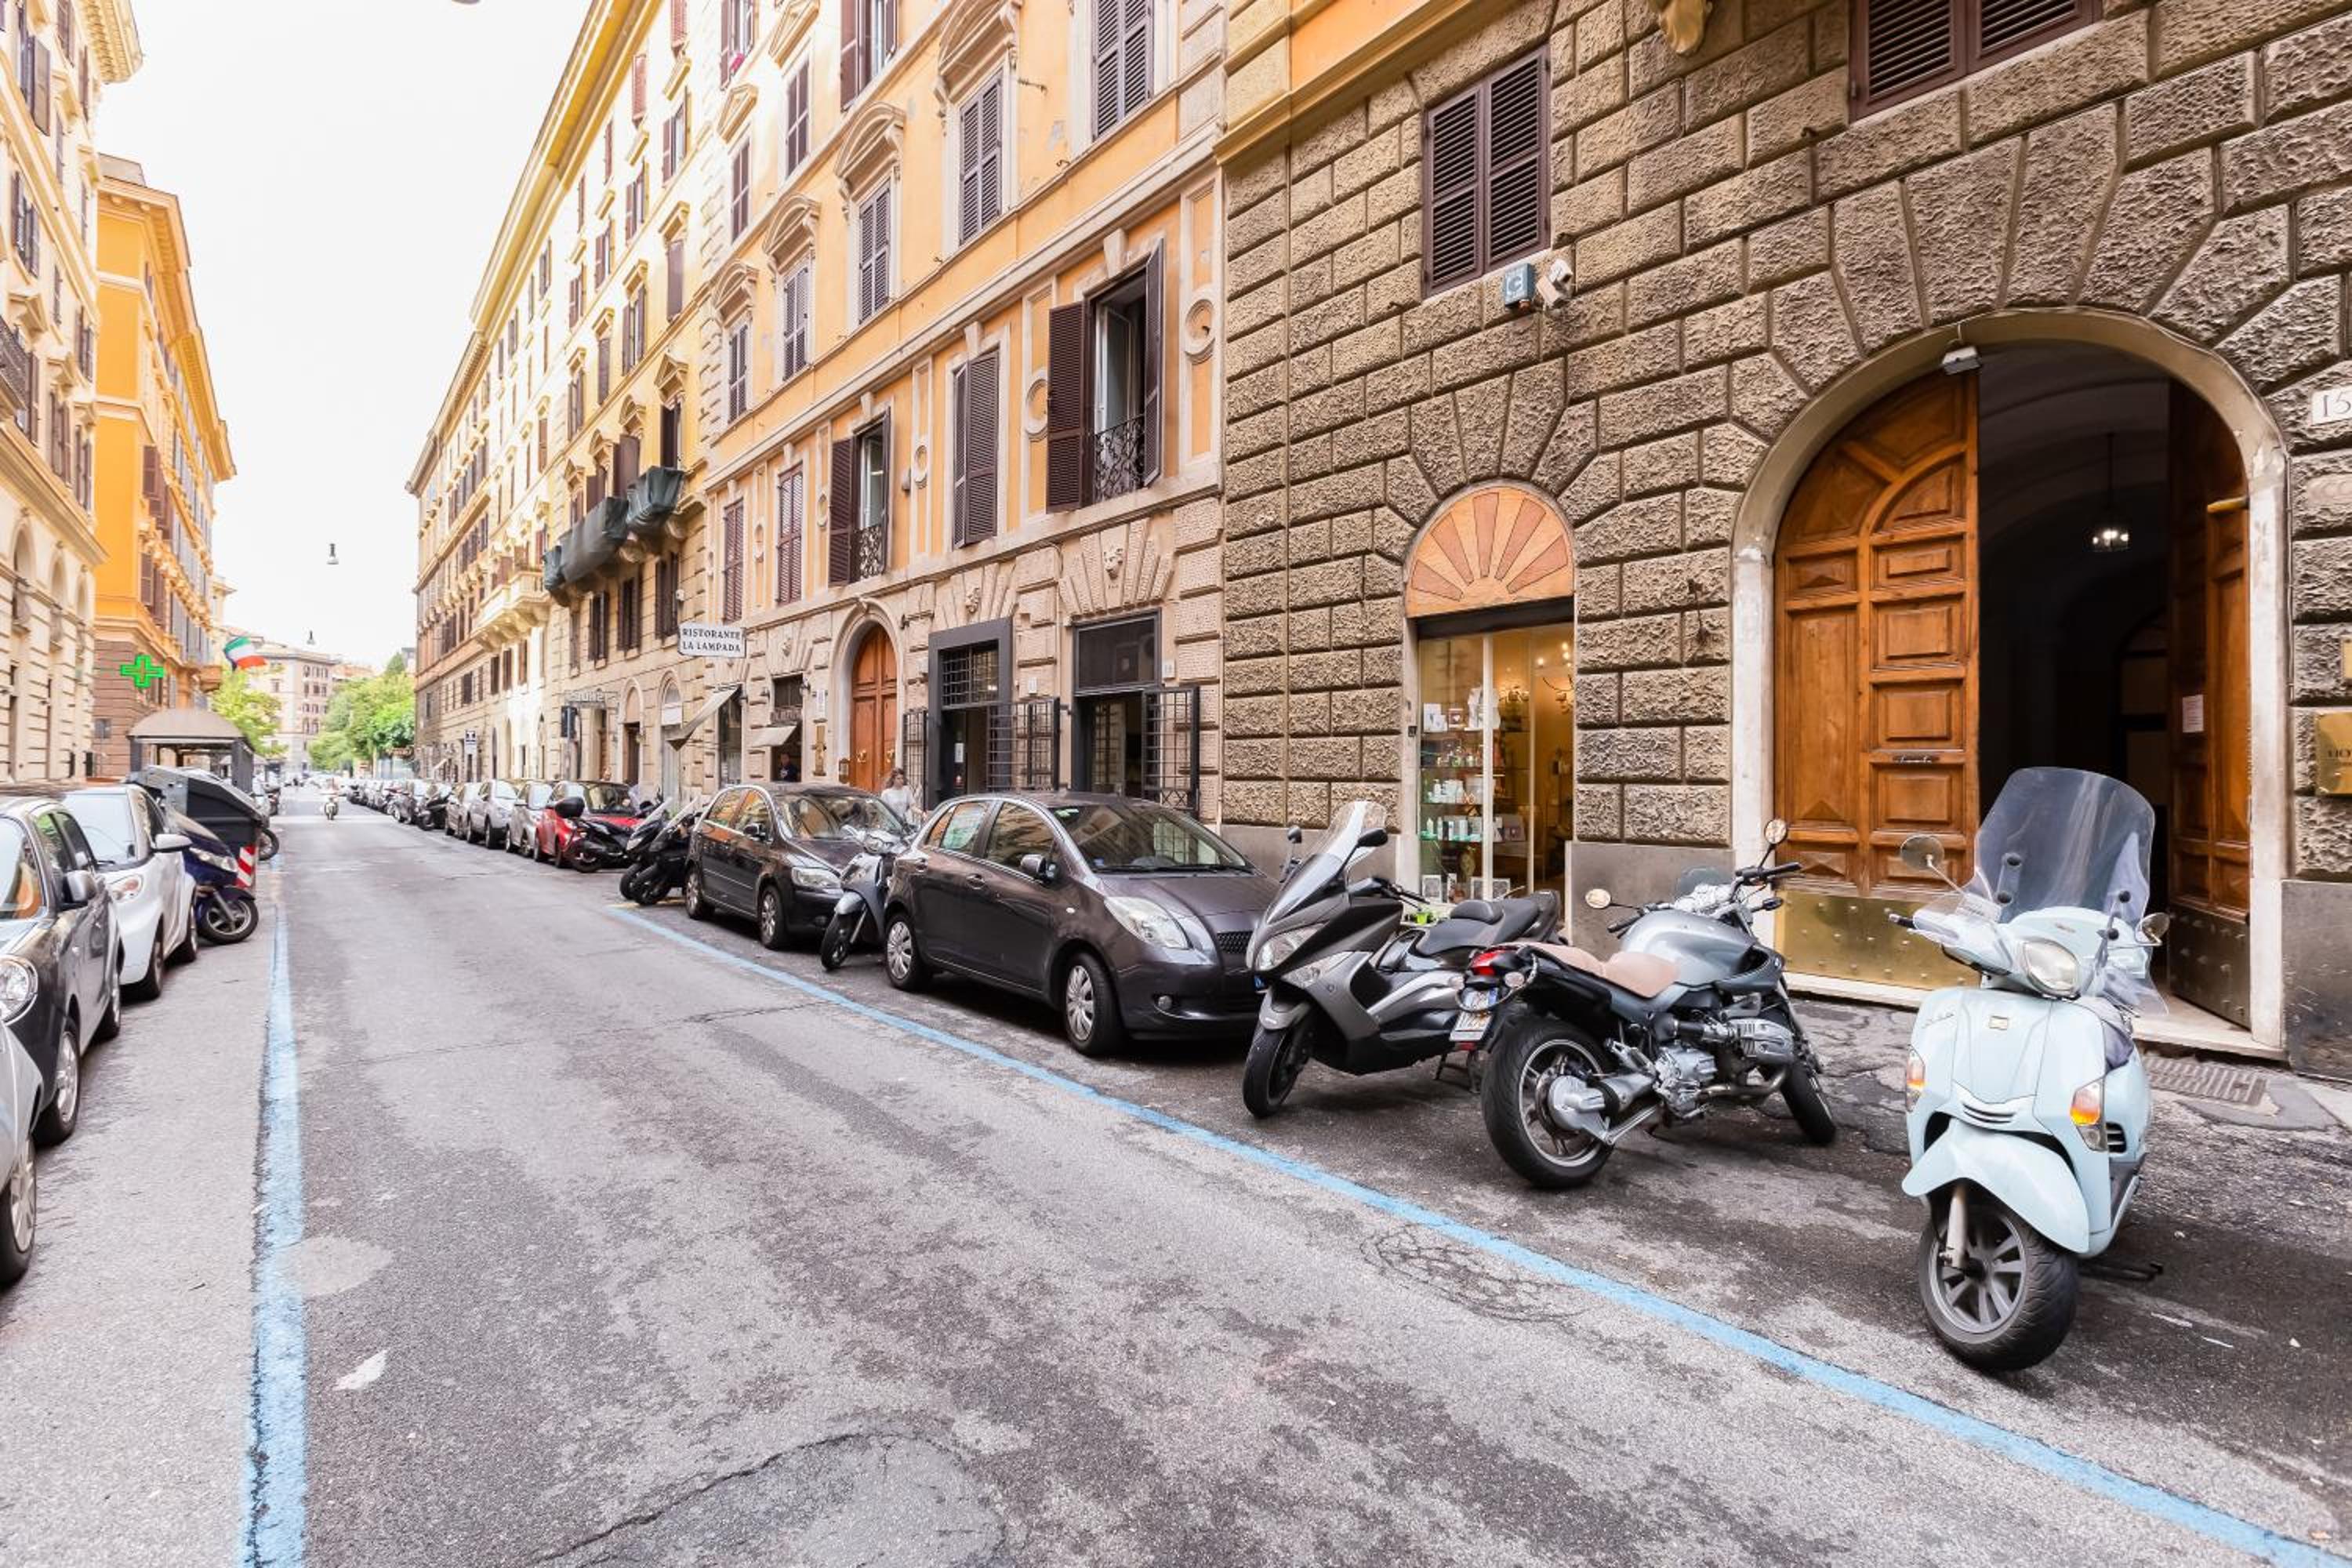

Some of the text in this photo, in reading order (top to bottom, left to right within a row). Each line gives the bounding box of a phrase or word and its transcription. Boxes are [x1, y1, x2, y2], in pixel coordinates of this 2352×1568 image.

[682, 628, 740, 641] RISTORANTE
[683, 641, 741, 652] LA LAMPADA
